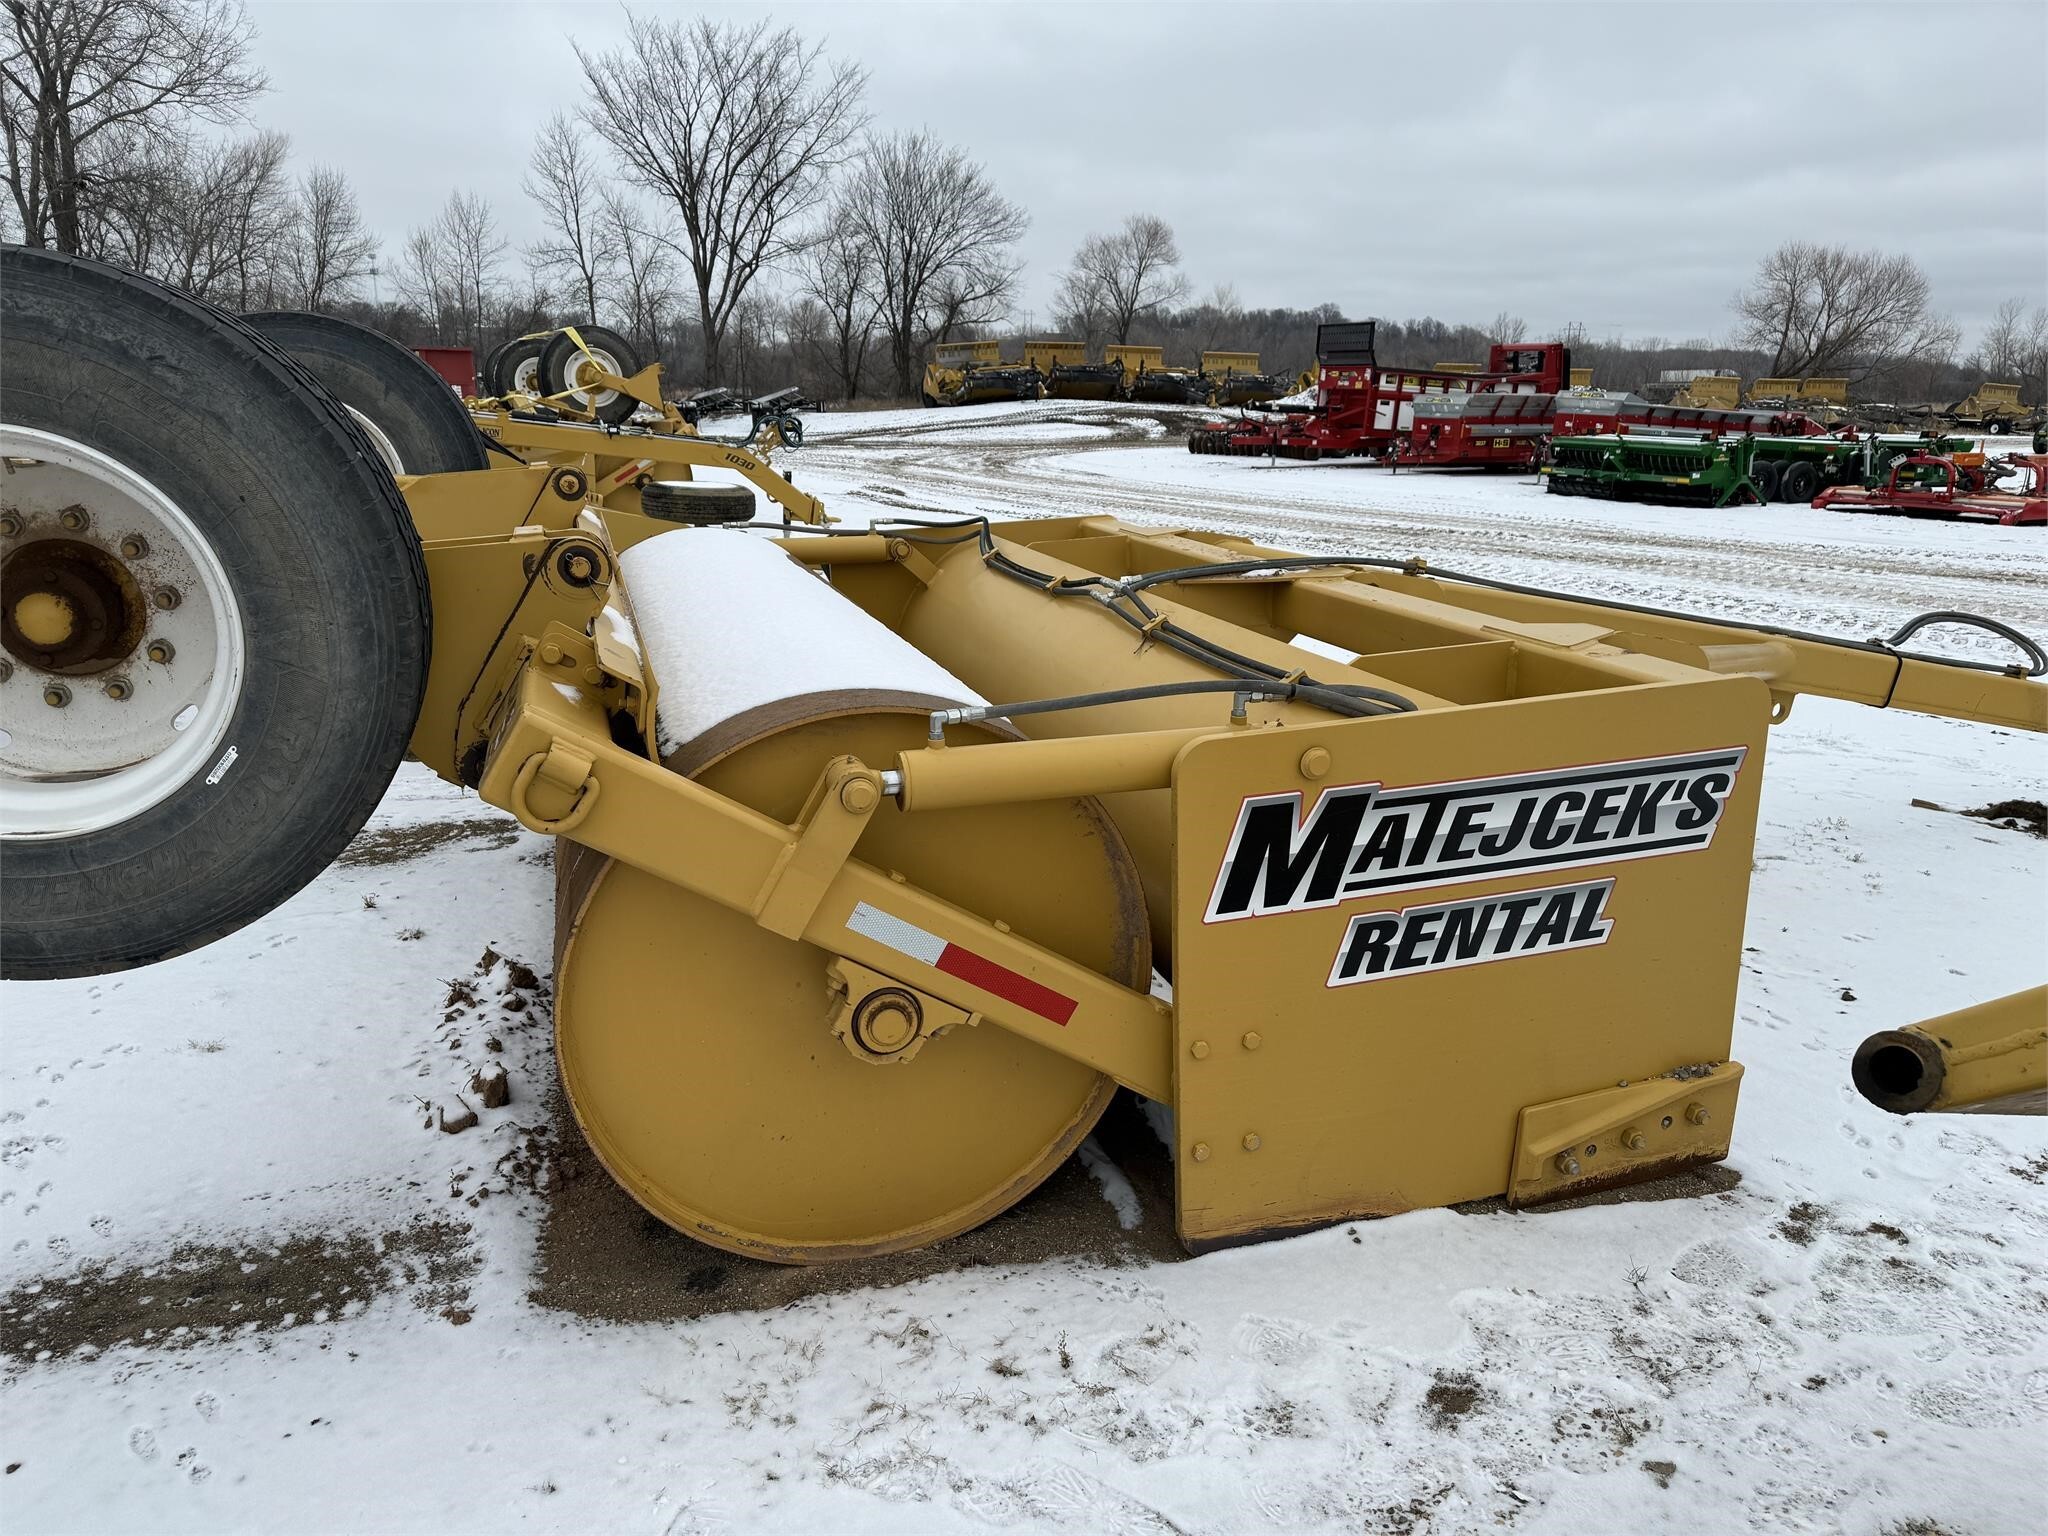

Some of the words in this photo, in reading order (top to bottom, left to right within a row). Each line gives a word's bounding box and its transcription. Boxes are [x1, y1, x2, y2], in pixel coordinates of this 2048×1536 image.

[725, 453, 755, 470] 1030
[1216, 772, 1731, 915] MATEJCEK'S
[1338, 888, 1606, 979] RENTAL
